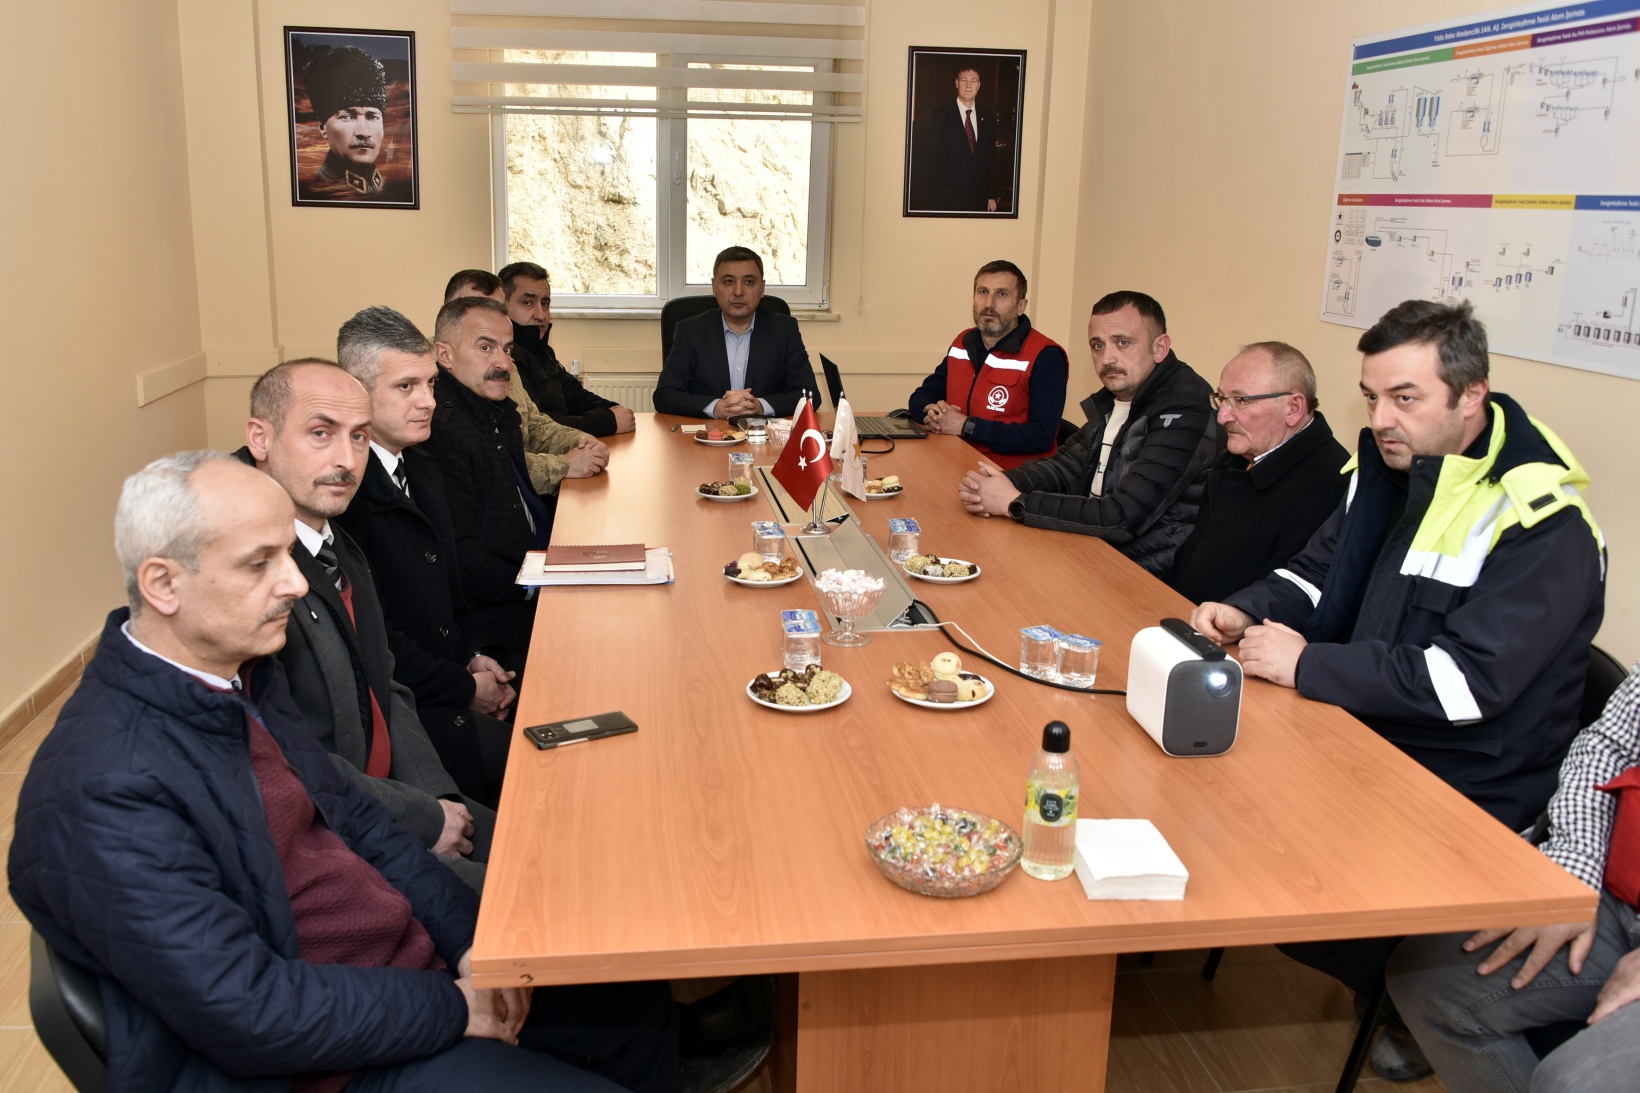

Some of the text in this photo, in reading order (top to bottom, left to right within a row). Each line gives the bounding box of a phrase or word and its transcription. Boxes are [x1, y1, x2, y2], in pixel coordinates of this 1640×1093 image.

[1456, 27, 1480, 38] Madencilik
[1501, 17, 1536, 31] Zenginleştirme
[1536, 14, 1550, 24] Tesisi
[1550, 12, 1564, 21] Akım
